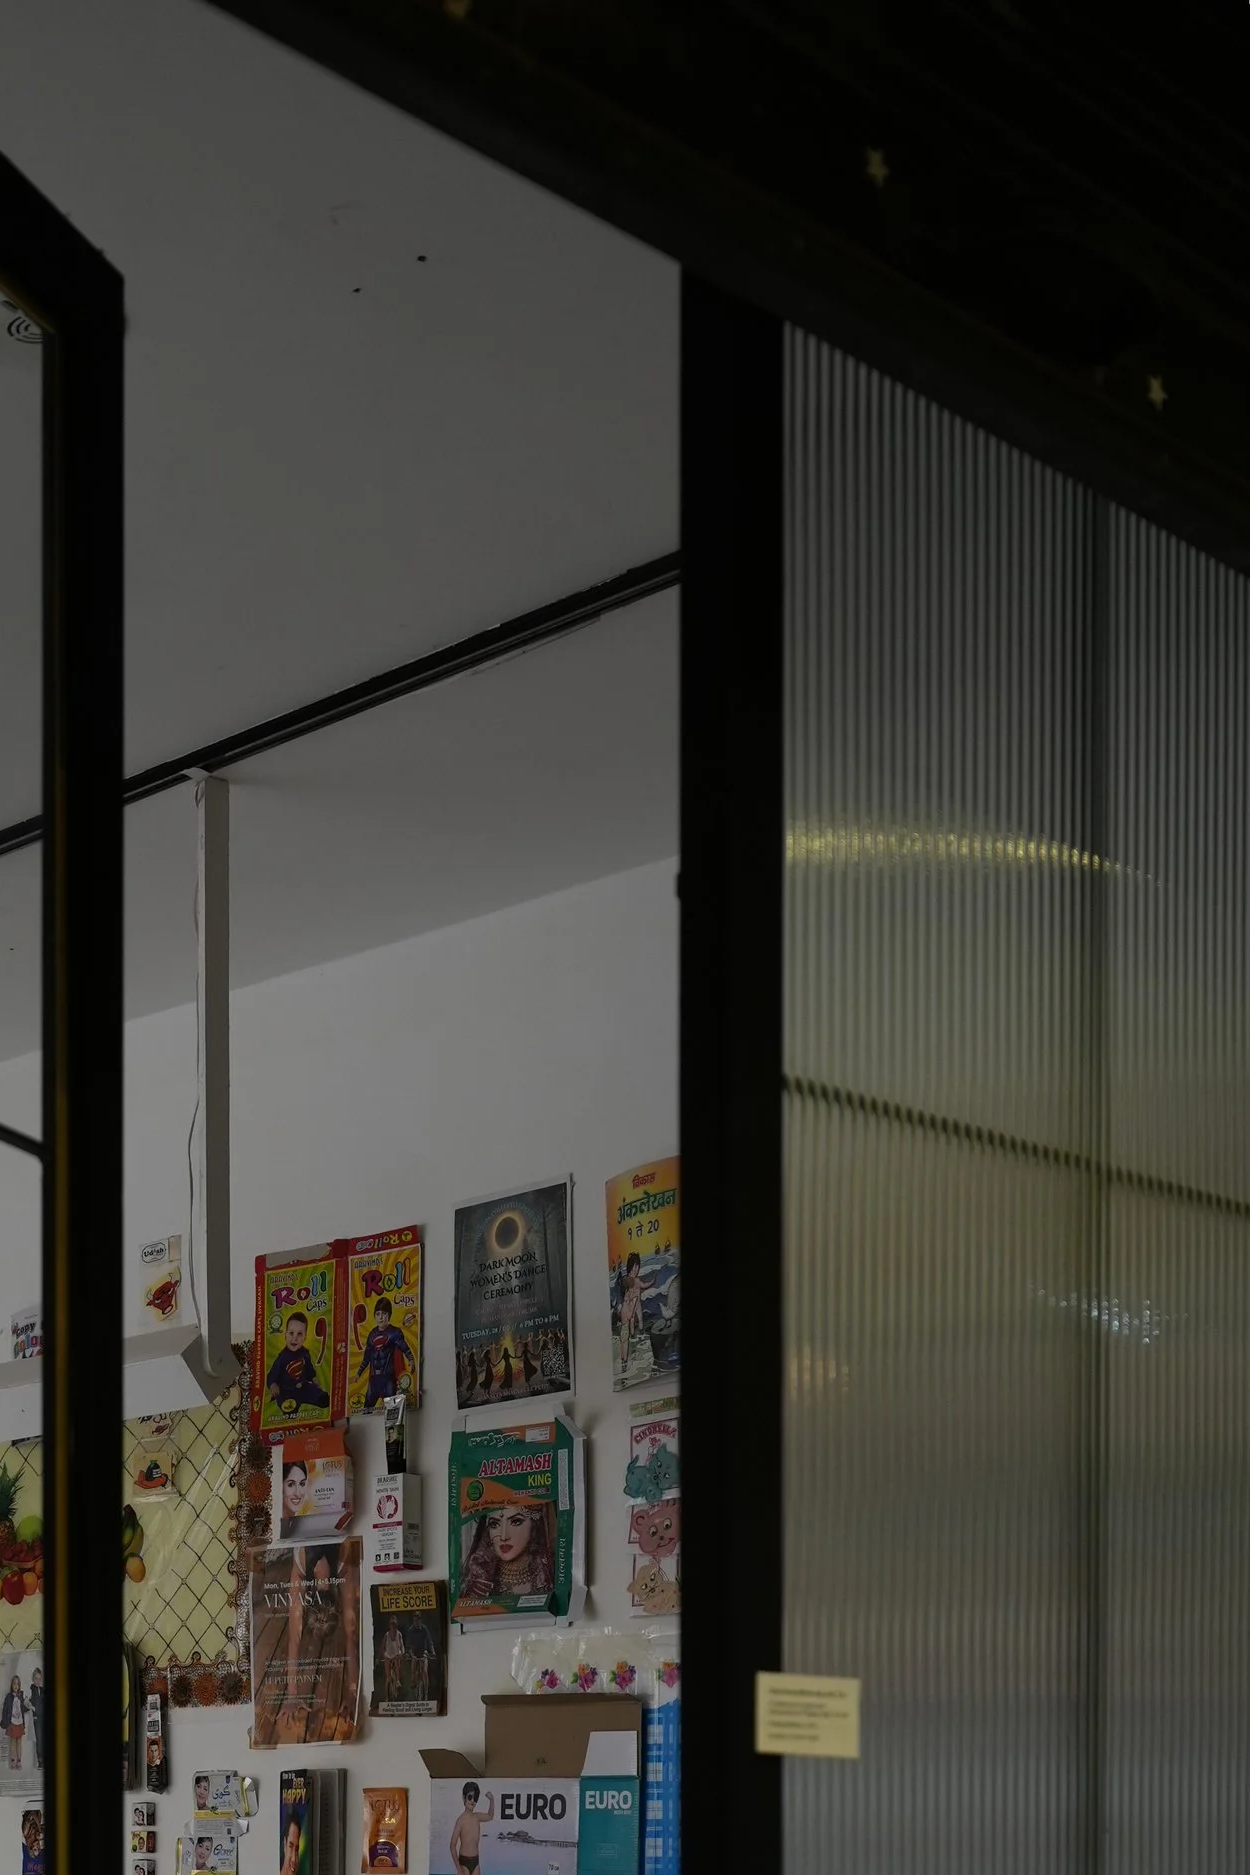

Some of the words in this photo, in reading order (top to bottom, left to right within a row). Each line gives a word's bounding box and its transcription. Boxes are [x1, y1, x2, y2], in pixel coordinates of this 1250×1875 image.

[617, 1188, 677, 1225] अंकलेखन
[479, 1258, 506, 1273] DARK
[505, 1251, 538, 1267] MOON
[361, 1257, 411, 1299] Roll
[470, 1271, 513, 1289] WOMEN'S
[514, 1264, 546, 1280] DANCE
[271, 1270, 327, 1310] Roll
[483, 1281, 534, 1301] CEREMONY
[306, 1298, 327, 1313] Caps
[393, 1293, 415, 1309] Caps
[478, 1451, 553, 1478] ALTAMASH
[528, 1473, 552, 1487] KING
[264, 1590, 323, 1608] VINYASA
[382, 1587, 412, 1597] INCREASE
[413, 1585, 430, 1595] YOUR
[382, 1597, 401, 1610] LIFE
[402, 1595, 433, 1609] SCORE
[282, 1788, 307, 1805] HAPPY
[500, 1793, 567, 1820] EURO
[585, 1790, 632, 1810] EURO
